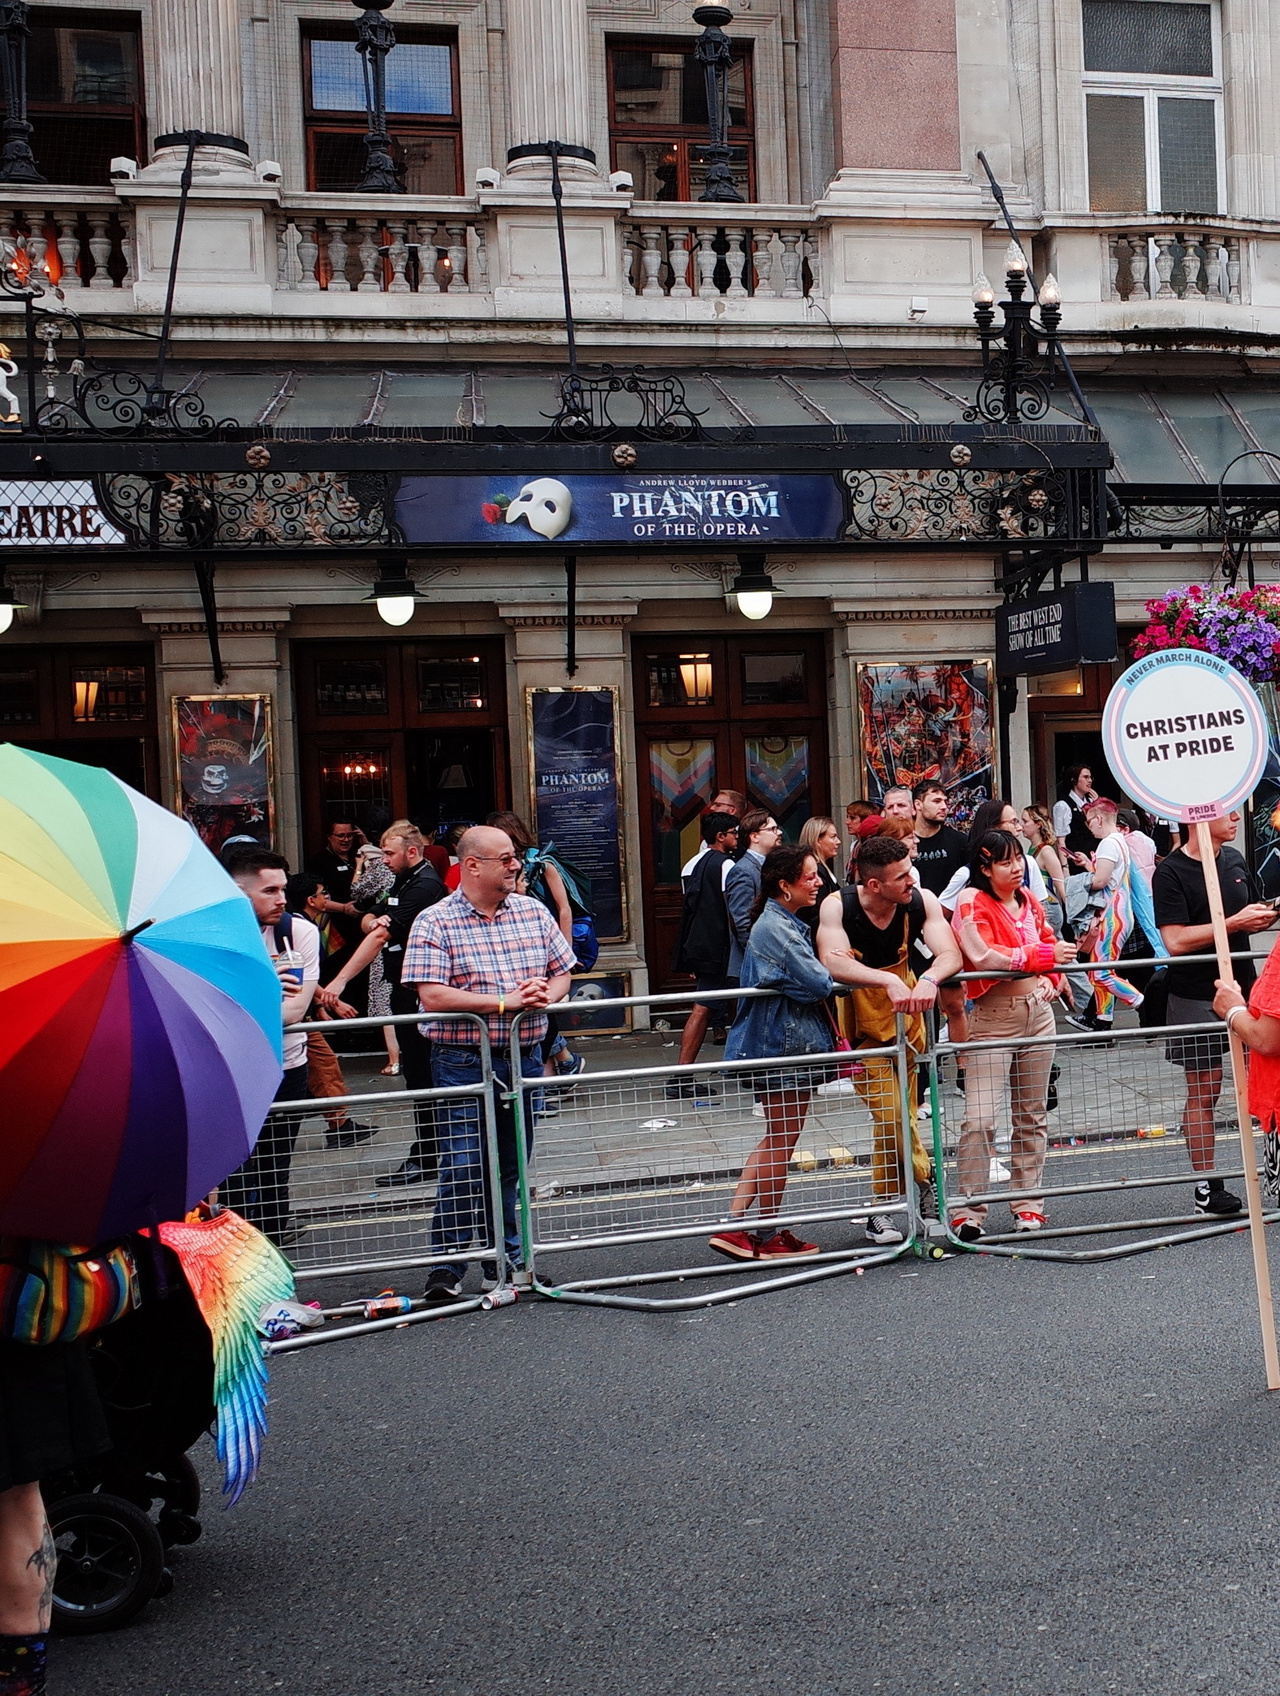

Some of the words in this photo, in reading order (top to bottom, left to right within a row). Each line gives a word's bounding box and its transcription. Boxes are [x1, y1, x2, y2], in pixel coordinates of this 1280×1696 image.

[609, 489, 781, 518] PHANTOM
[633, 523, 656, 536] OF
[662, 523, 696, 536] THE
[703, 523, 761, 536] OPERA
[1007, 614, 1019, 633] THE
[1019, 610, 1032, 630] BEST
[1032, 606, 1049, 626] WEST
[1049, 603, 1063, 623] END
[1008, 632, 1025, 652] SHOW
[1025, 630, 1033, 649] OF
[1033, 628, 1045, 647] ALL
[1125, 661, 1155, 686] NEVER
[1155, 653, 1192, 666] MARCH
[1193, 655, 1226, 675] ALONE
[1125, 708, 1245, 740] CHRISTIANS
[1147, 744, 1170, 763] AT
[1175, 735, 1235, 759] PRIDE
[541, 772, 610, 786] PHANTOM
[1188, 804, 1216, 815] PRIDE
